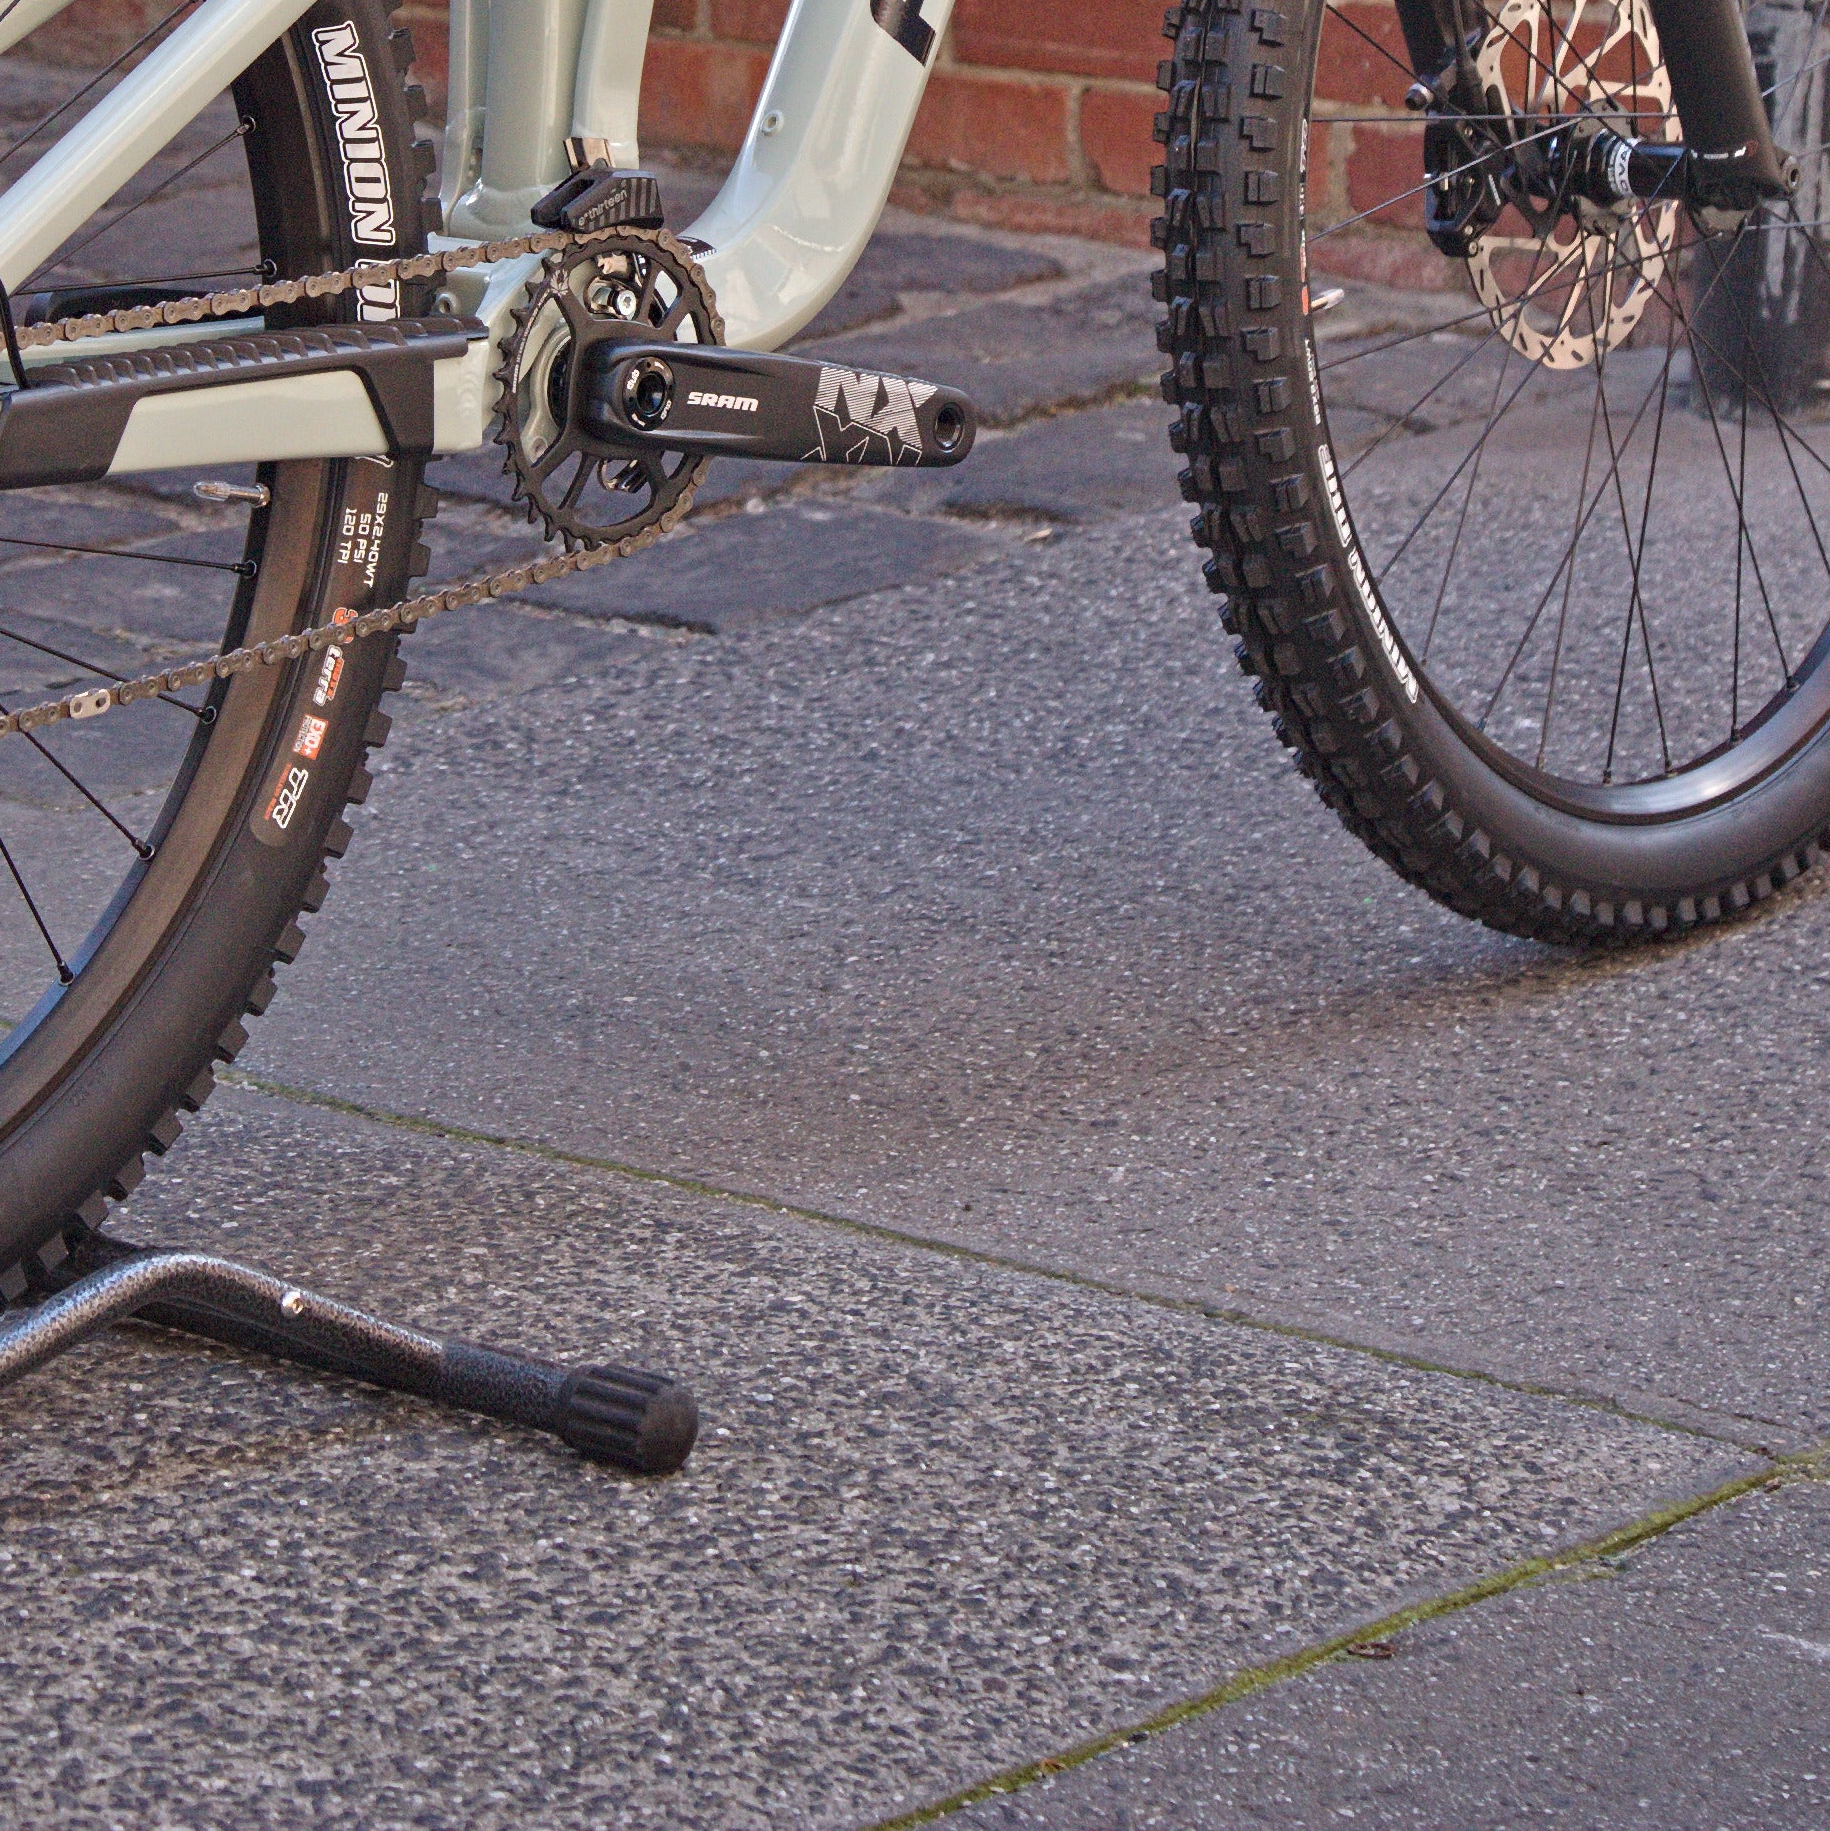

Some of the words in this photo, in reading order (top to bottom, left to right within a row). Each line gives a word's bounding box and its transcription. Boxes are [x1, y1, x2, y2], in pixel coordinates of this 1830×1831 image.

[311, 20, 396, 245] MINION
[687, 391, 759, 412] SRAM
[342, 507, 357, 536] 120
[358, 513, 371, 535] 50
[337, 540, 352, 564] TPI
[353, 537, 368, 563] PSI
[363, 492, 389, 588] 29X2.40WT
[272, 767, 309, 829] TR
